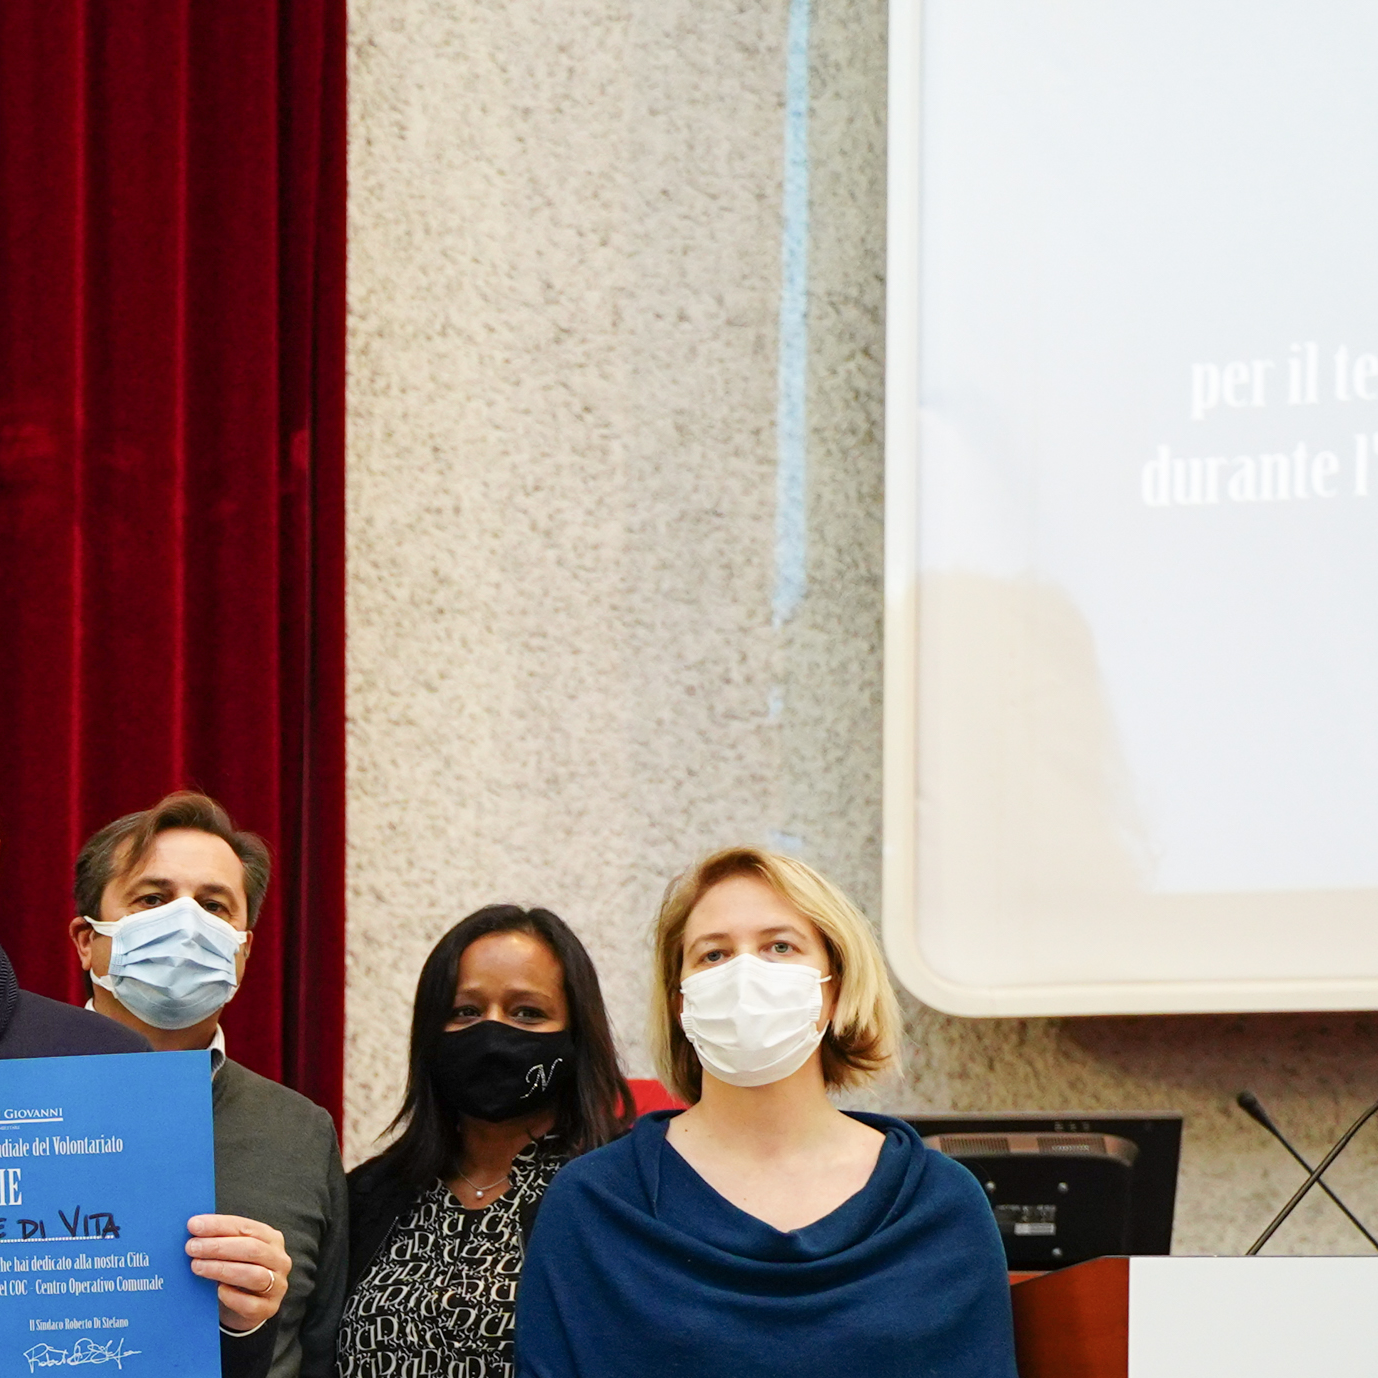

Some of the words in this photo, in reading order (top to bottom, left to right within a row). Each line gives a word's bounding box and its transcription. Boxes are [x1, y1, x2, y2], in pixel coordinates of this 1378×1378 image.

[1190, 360, 1275, 421] per
[1287, 340, 1319, 405] il
[1141, 440, 1339, 507] durante
[4, 1108, 63, 1119] GIOVANNI
[32, 1137, 50, 1156] del
[52, 1134, 123, 1155] Volontariato
[17, 1219, 46, 1240] DI
[58, 1205, 120, 1239] VITA
[13, 1256, 29, 1272] hai
[31, 1255, 72, 1271] dedicato
[74, 1253, 92, 1270] alla
[94, 1254, 125, 1269] nostra
[126, 1251, 149, 1267] Città
[9, 1279, 28, 1296] COC
[35, 1278, 67, 1295] Centro
[68, 1276, 114, 1296] Operativo
[116, 1274, 164, 1292] Comunale
[35, 1319, 64, 1331] Sindaco
[64, 1318, 92, 1330] Roberto
[93, 1317, 101, 1329] Di
[102, 1316, 129, 1328] Stefano
